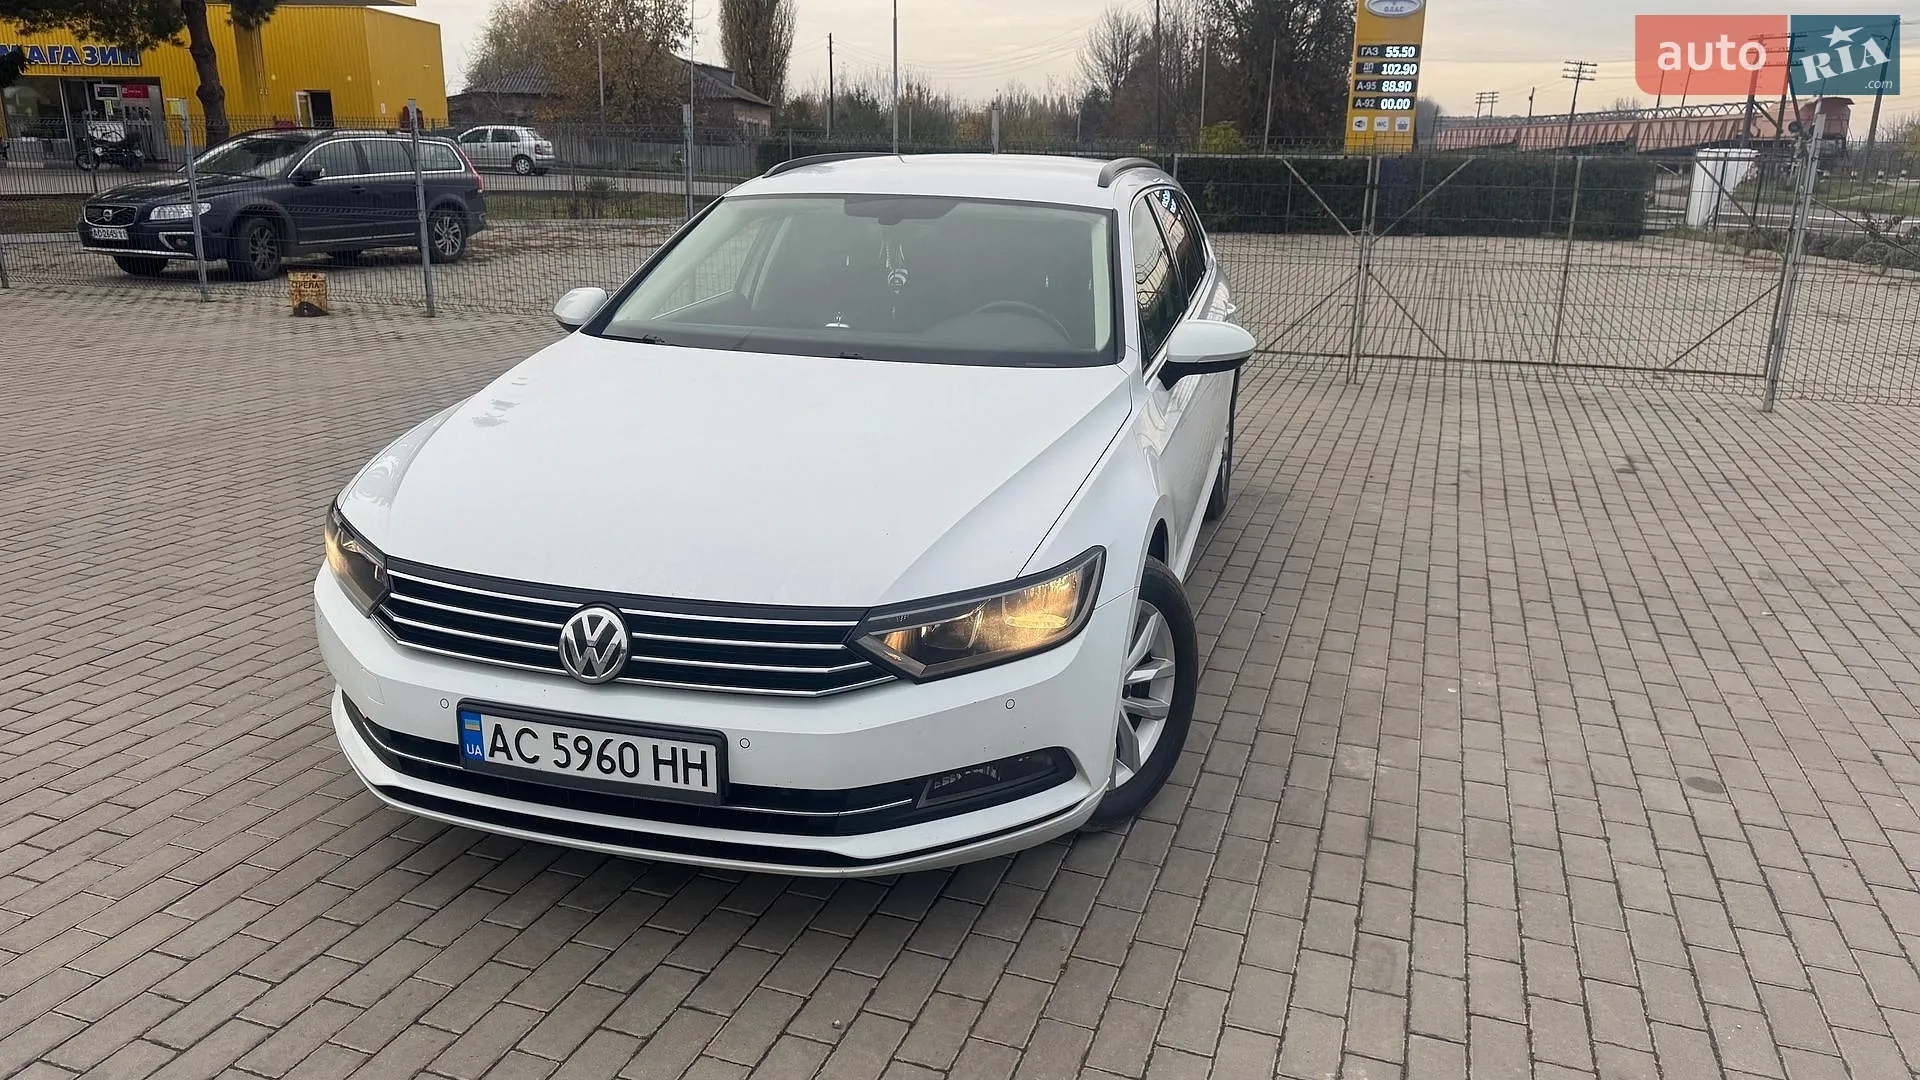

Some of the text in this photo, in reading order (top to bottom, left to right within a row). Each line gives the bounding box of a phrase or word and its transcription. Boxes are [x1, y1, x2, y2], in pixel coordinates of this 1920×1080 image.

[1360, 46, 1416, 58] ГАЗ 55.50
[1381, 63, 1417, 75] 102.90
[1356, 80, 1412, 92] А-95 88.90
[1355, 98, 1410, 110] А-92 00.00
[466, 743, 482, 756] UA
[488, 723, 708, 787] AC 5960 HH
